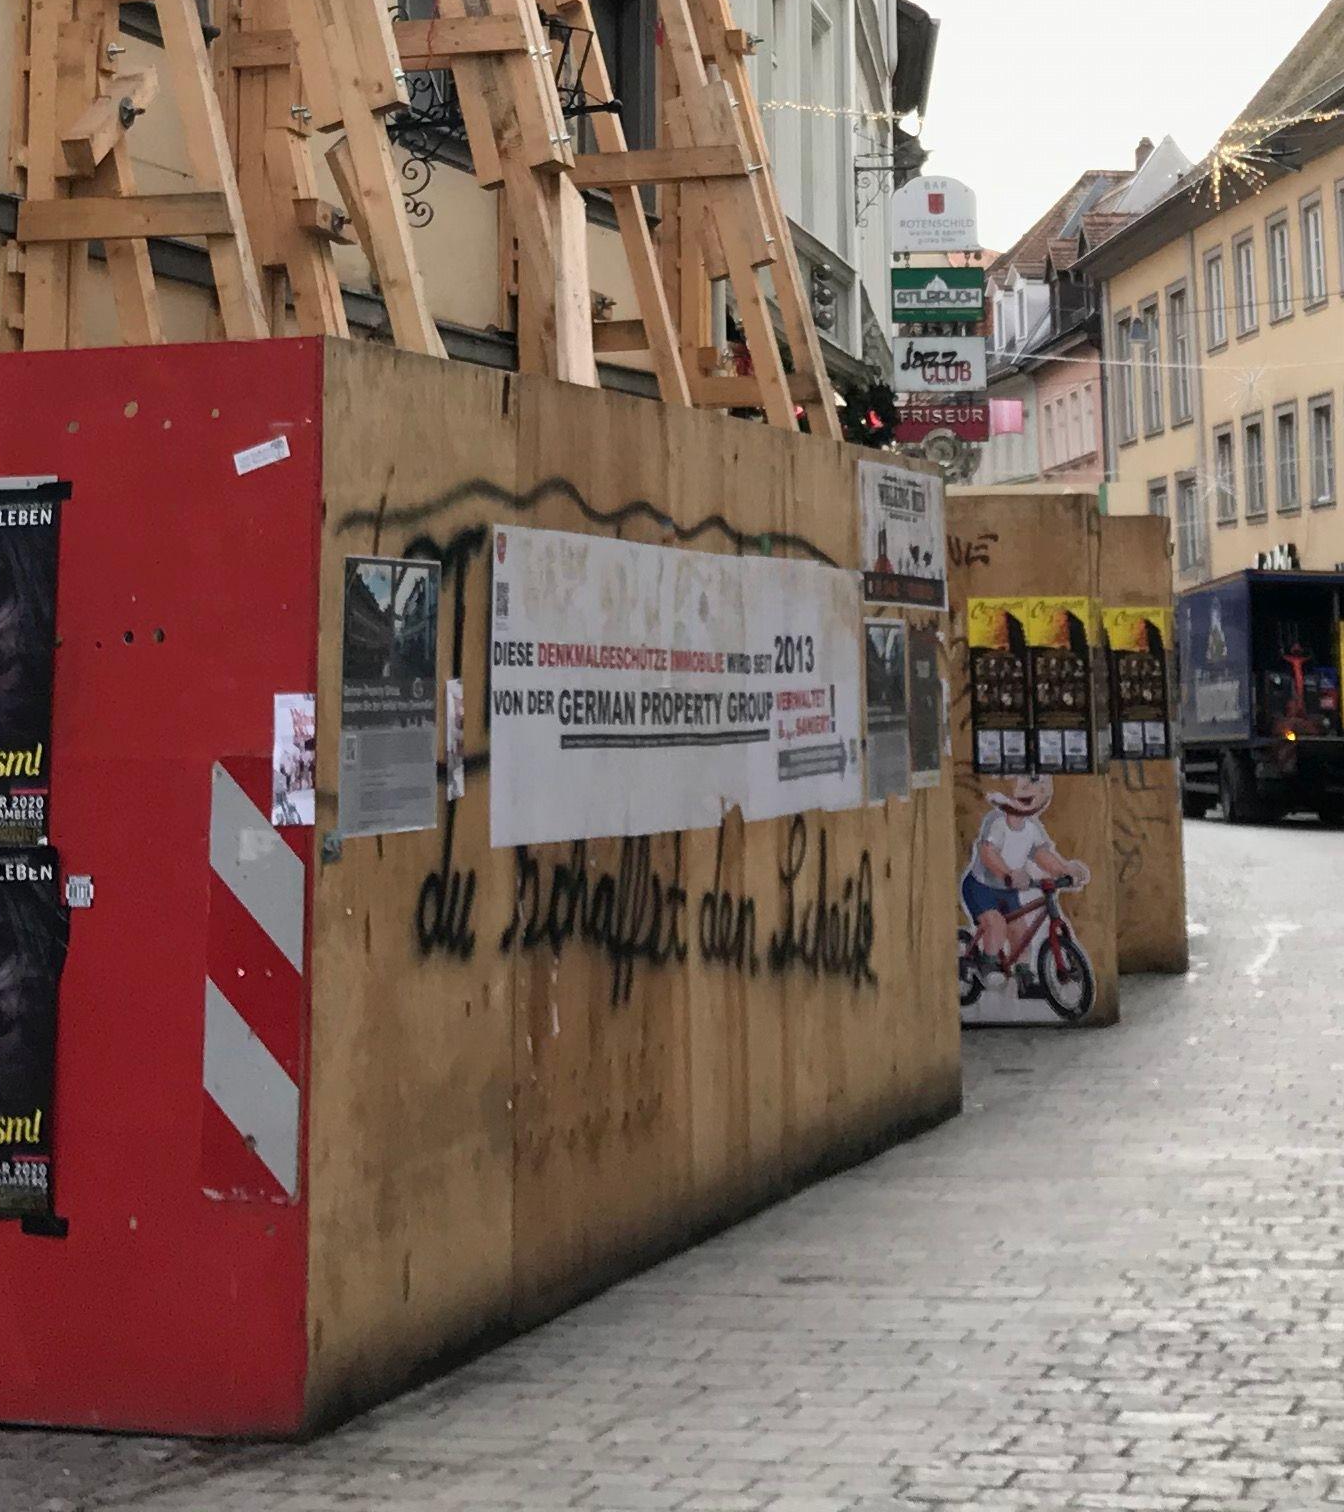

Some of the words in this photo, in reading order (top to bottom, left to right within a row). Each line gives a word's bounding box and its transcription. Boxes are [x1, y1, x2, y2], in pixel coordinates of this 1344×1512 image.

[924, 181, 948, 190] BAR
[899, 219, 975, 229] ROTENSCHILD
[896, 289, 980, 305] STILBRUCH
[921, 360, 972, 382] CLUB
[899, 408, 984, 424] FRISEUR
[493, 640, 534, 667] DIESE
[753, 653, 773, 674] SEIT
[774, 635, 816, 674] 2013
[493, 690, 524, 716] VON
[527, 690, 555, 716] DER
[558, 689, 636, 726] GERMAN
[640, 691, 723, 726] PROPERTY
[727, 691, 774, 724] GROUP
[11, 796, 44, 809] 2020
